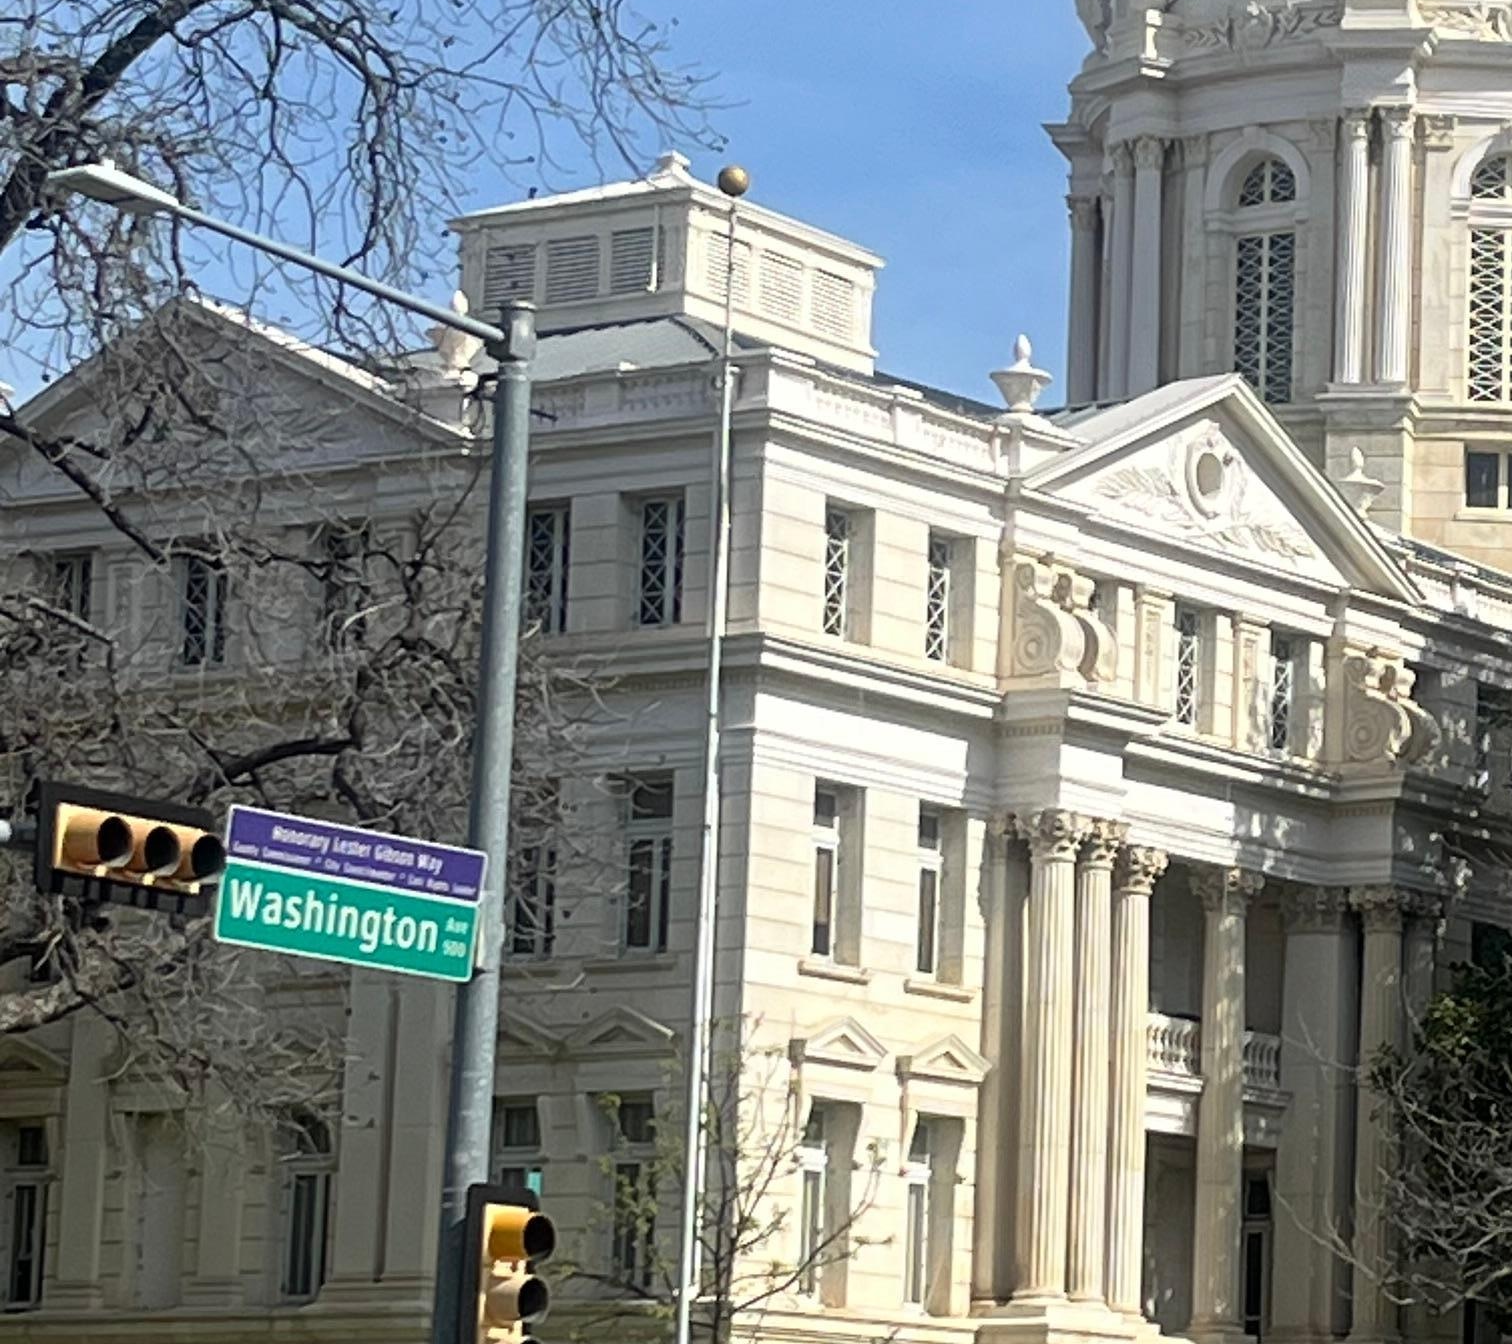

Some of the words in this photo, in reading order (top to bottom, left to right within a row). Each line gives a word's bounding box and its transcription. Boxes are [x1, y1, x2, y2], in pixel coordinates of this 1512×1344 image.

[272, 825, 330, 855] Honorary
[332, 836, 372, 858] Lester
[374, 843, 415, 867] Gibson
[416, 853, 444, 876] Way
[229, 877, 439, 954] Washington
[444, 916, 469, 936] Ave
